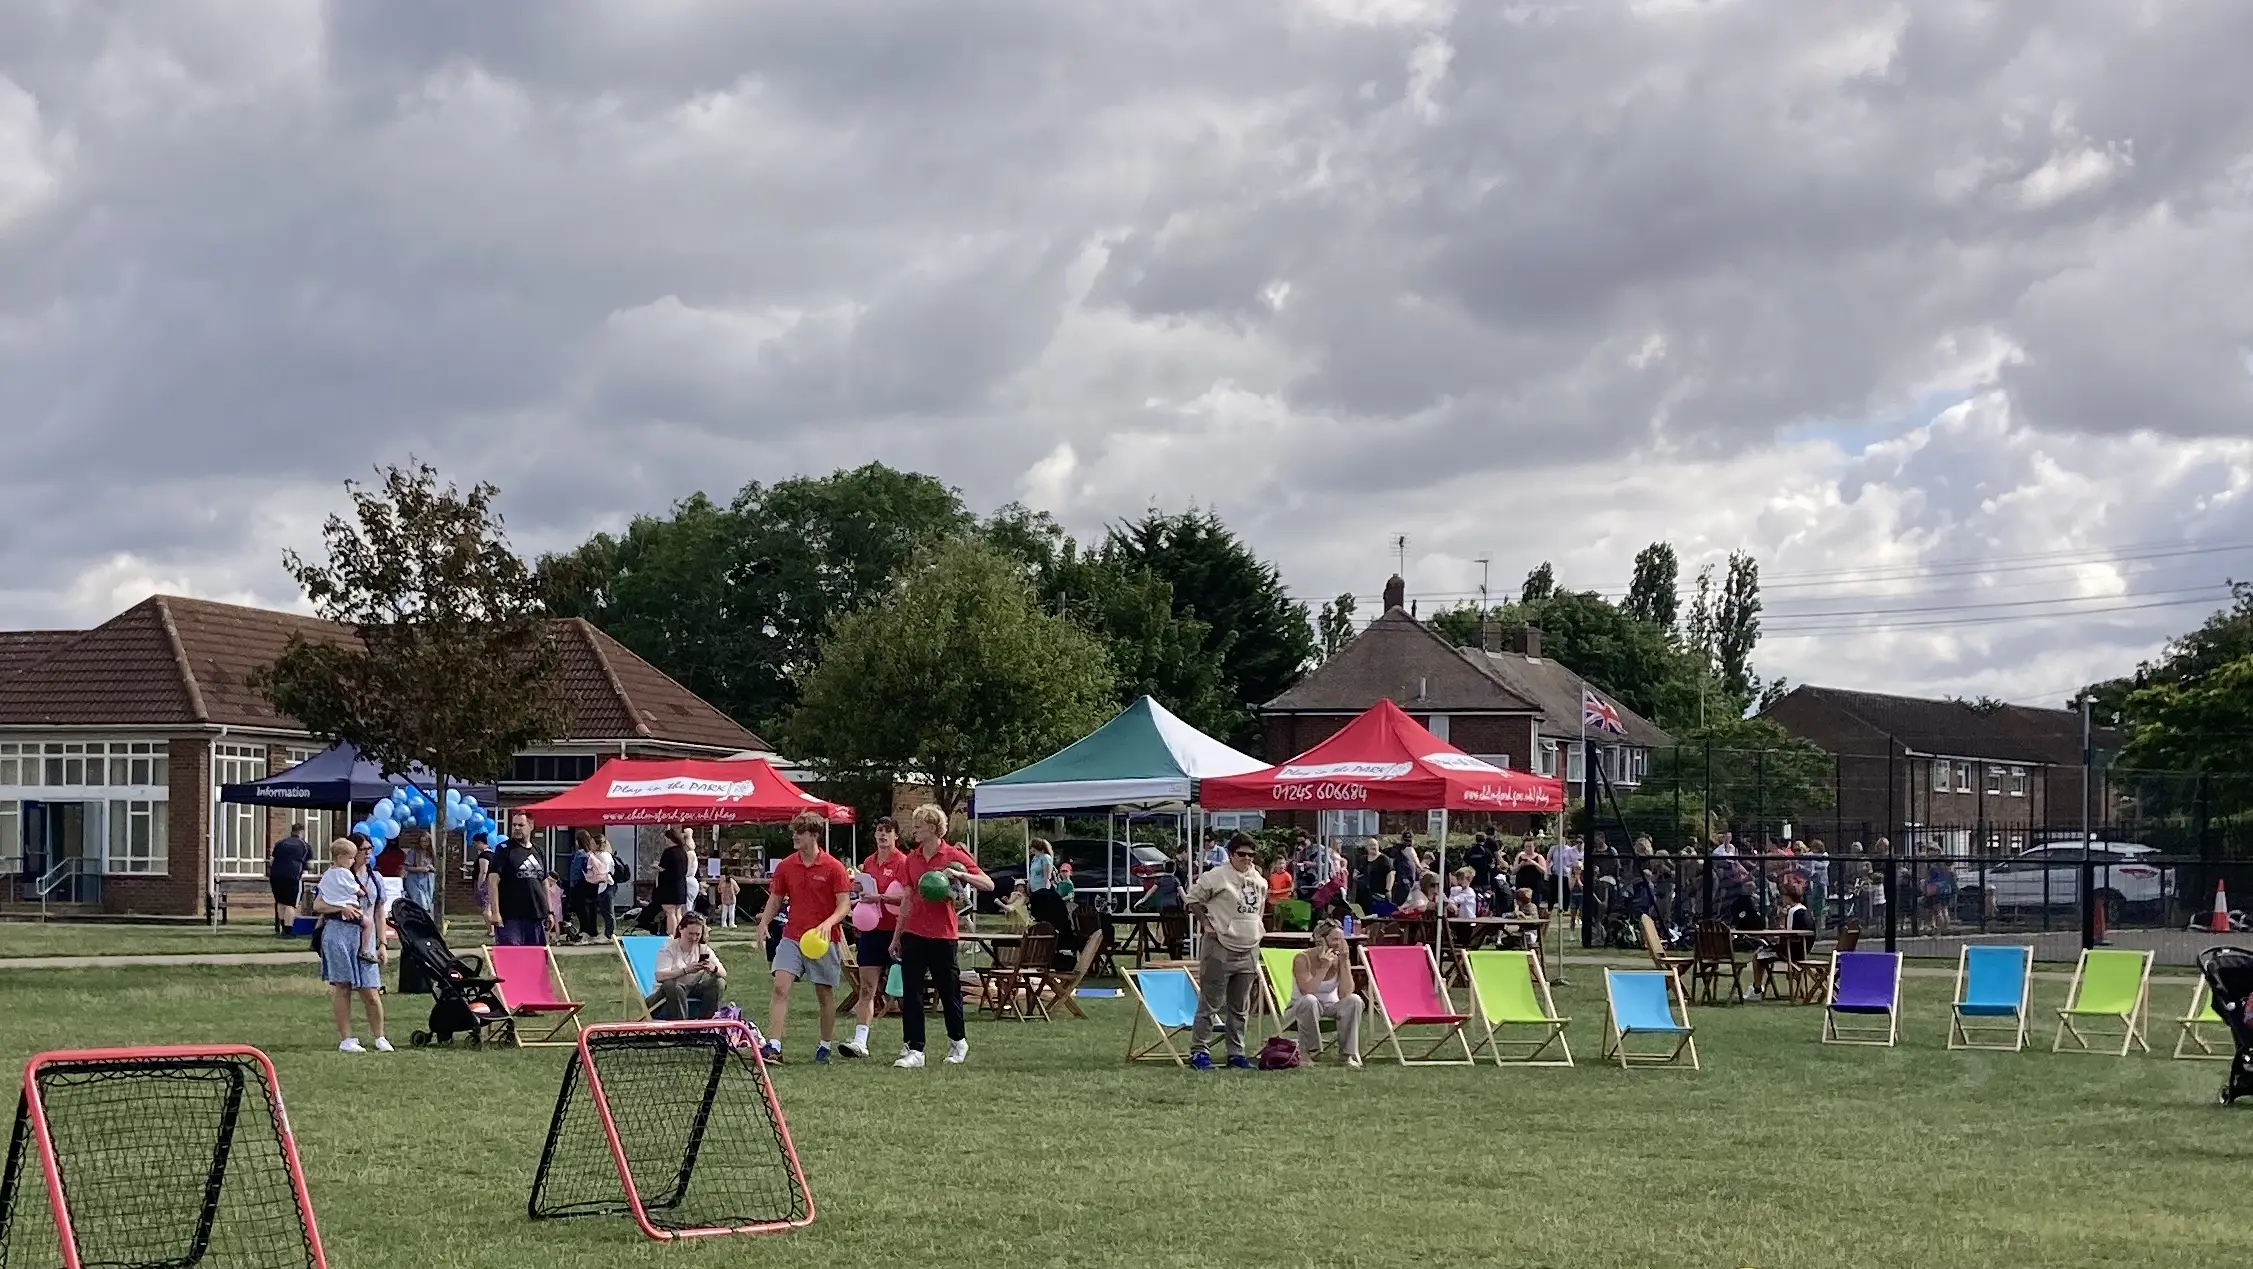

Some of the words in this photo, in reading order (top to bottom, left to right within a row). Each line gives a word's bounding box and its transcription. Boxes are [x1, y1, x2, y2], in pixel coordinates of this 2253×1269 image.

[256, 785, 311, 798] Information
[612, 784, 643, 795] Play
[667, 780, 685, 790] the
[689, 781, 728, 792] PARK
[1272, 783, 1315, 801] 01245
[1316, 782, 1368, 803] 606684
